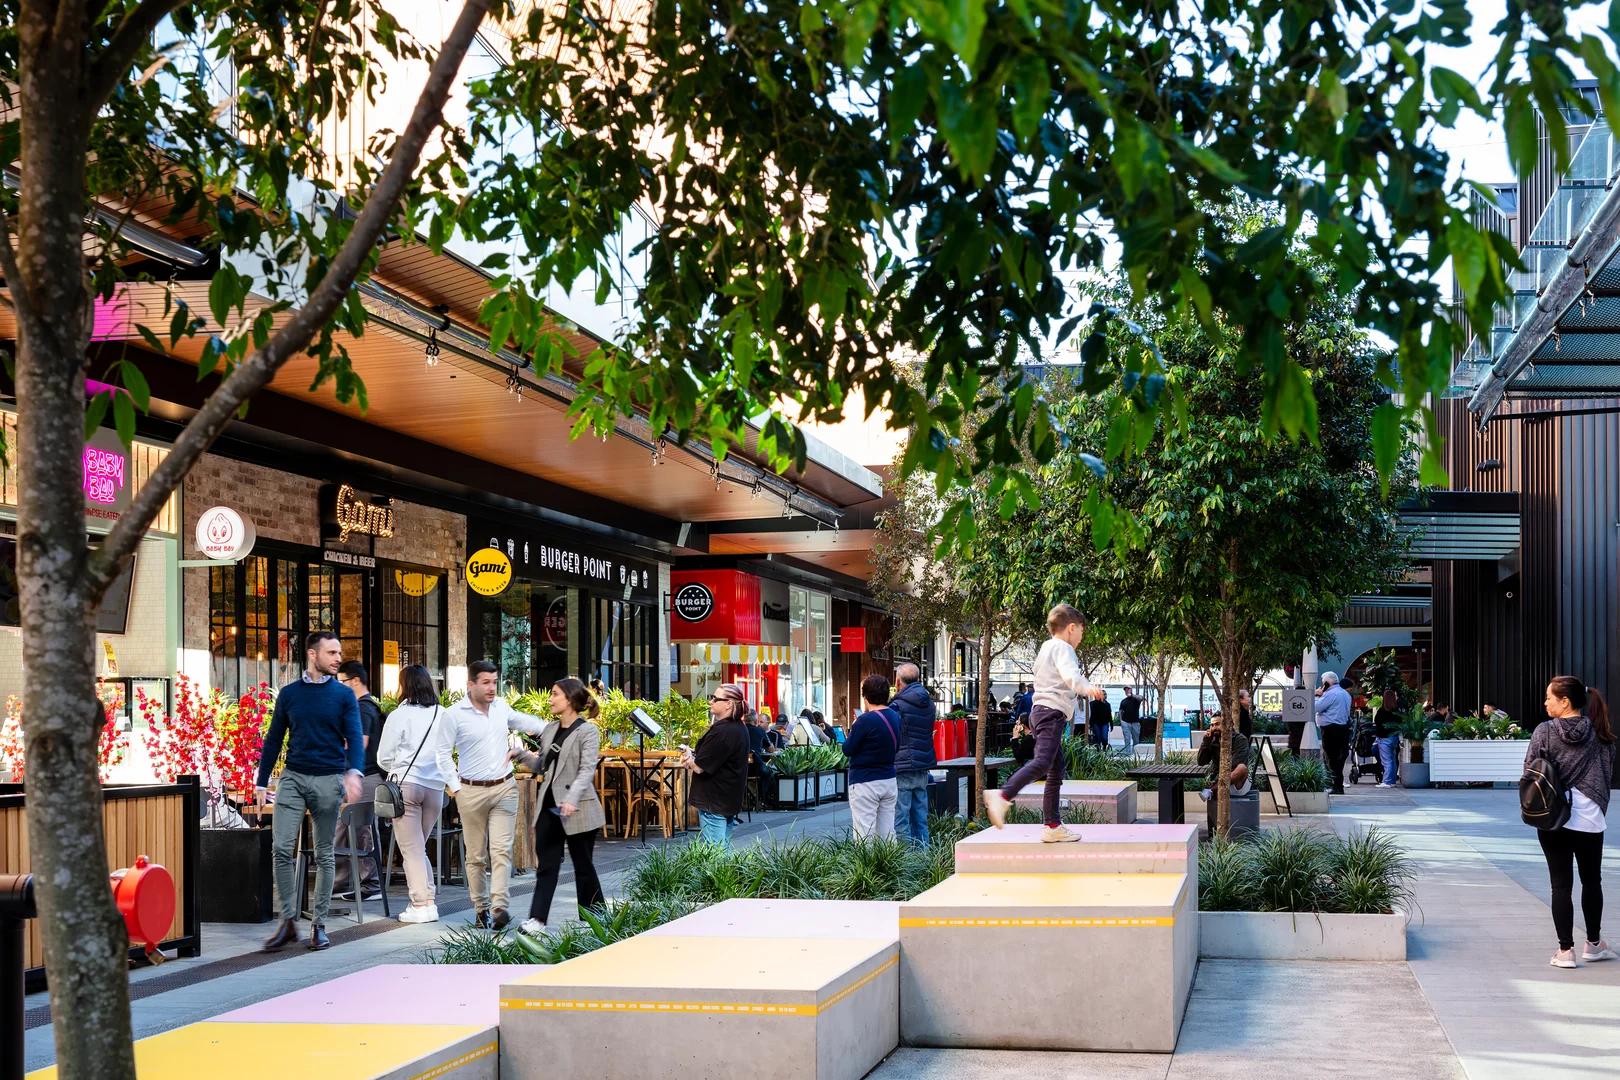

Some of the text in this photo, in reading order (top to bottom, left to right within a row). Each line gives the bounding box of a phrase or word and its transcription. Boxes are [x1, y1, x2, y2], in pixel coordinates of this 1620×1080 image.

[86, 449, 125, 488] BABY
[89, 475, 115, 502] BAO
[336, 484, 395, 543] Gami
[206, 545, 222, 553] BABY
[324, 550, 376, 568] CHICKEN & BEER
[540, 545, 612, 581] BURGER POINT
[469, 560, 508, 578] Gami
[470, 581, 490, 592] CHICKEN
[495, 580, 507, 590] BEER
[674, 598, 712, 606] BURGER
[1203, 693, 1218, 702] Ed.
[1261, 692, 1282, 704] Ed.
[1292, 702, 1305, 710] Ed.
